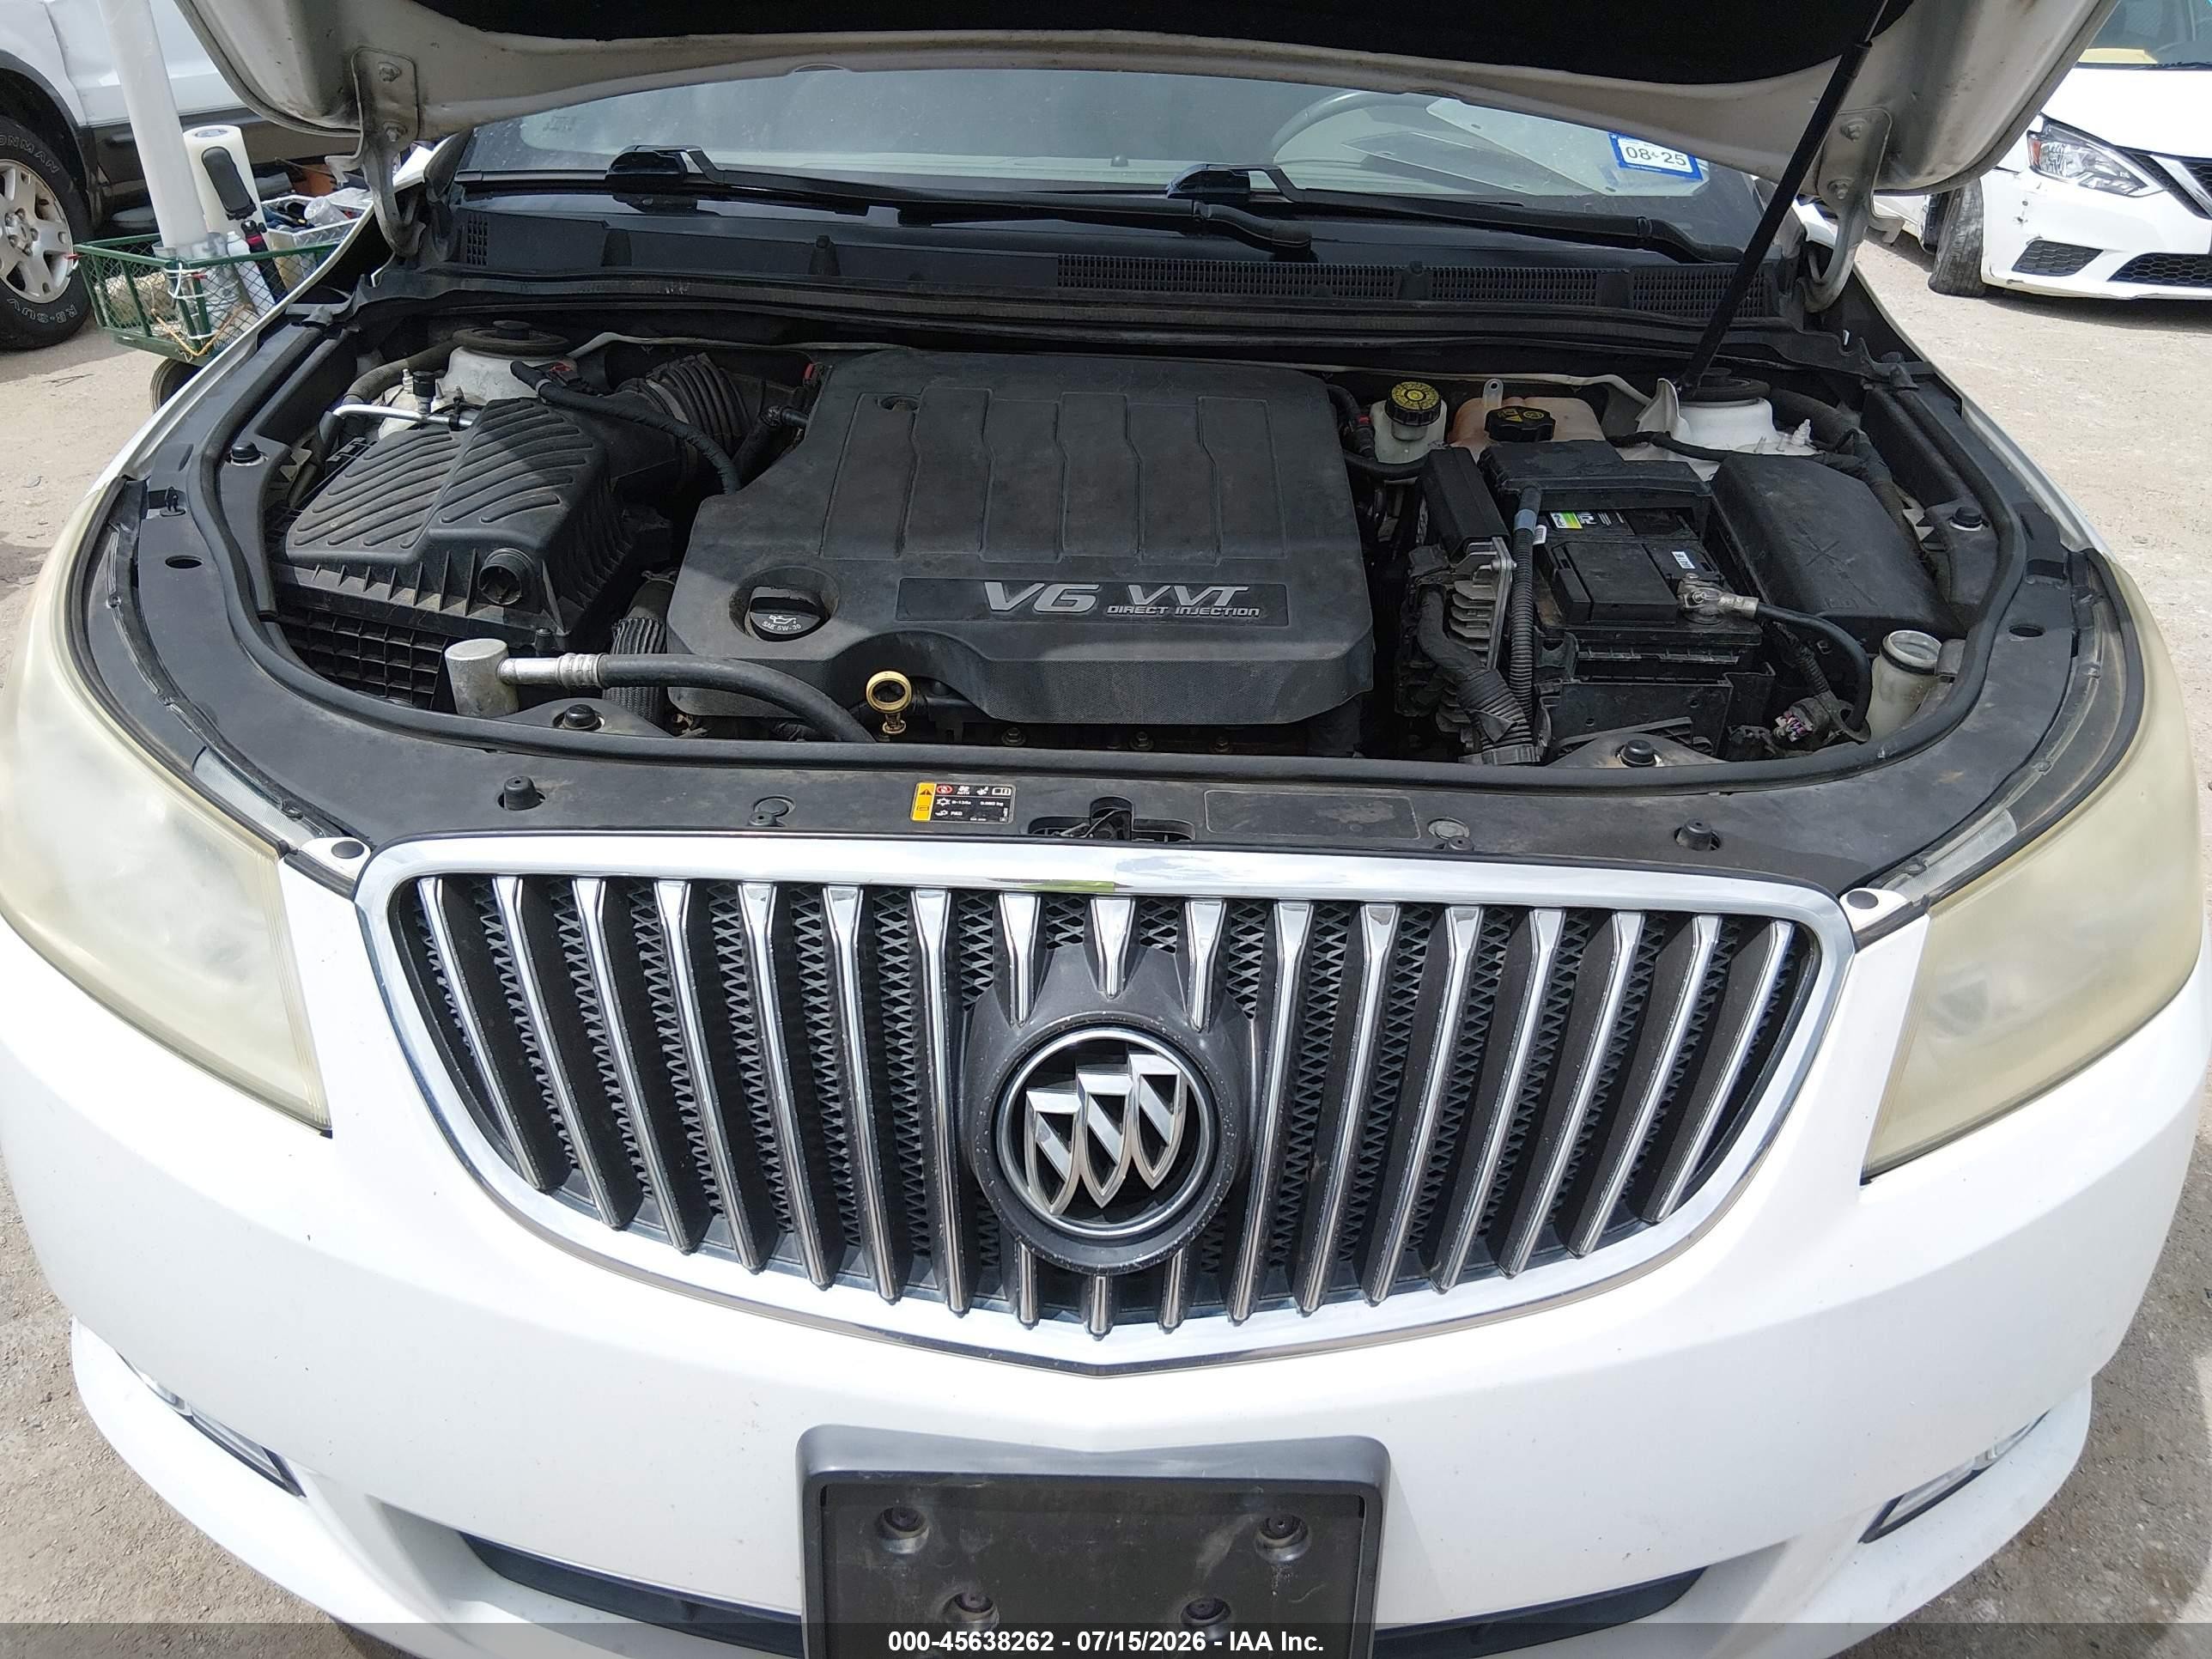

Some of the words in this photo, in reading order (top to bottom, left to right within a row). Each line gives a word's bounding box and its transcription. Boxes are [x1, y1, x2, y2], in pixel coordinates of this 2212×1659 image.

[1626, 146, 1652, 161] 08
[1661, 151, 1687, 167] 25
[984, 581, 1101, 613] V6
[1127, 584, 1250, 606] VVT
[1107, 605, 1169, 615] DIRECT
[1175, 606, 1261, 617] INJECTION
[762, 621, 776, 630] SAE
